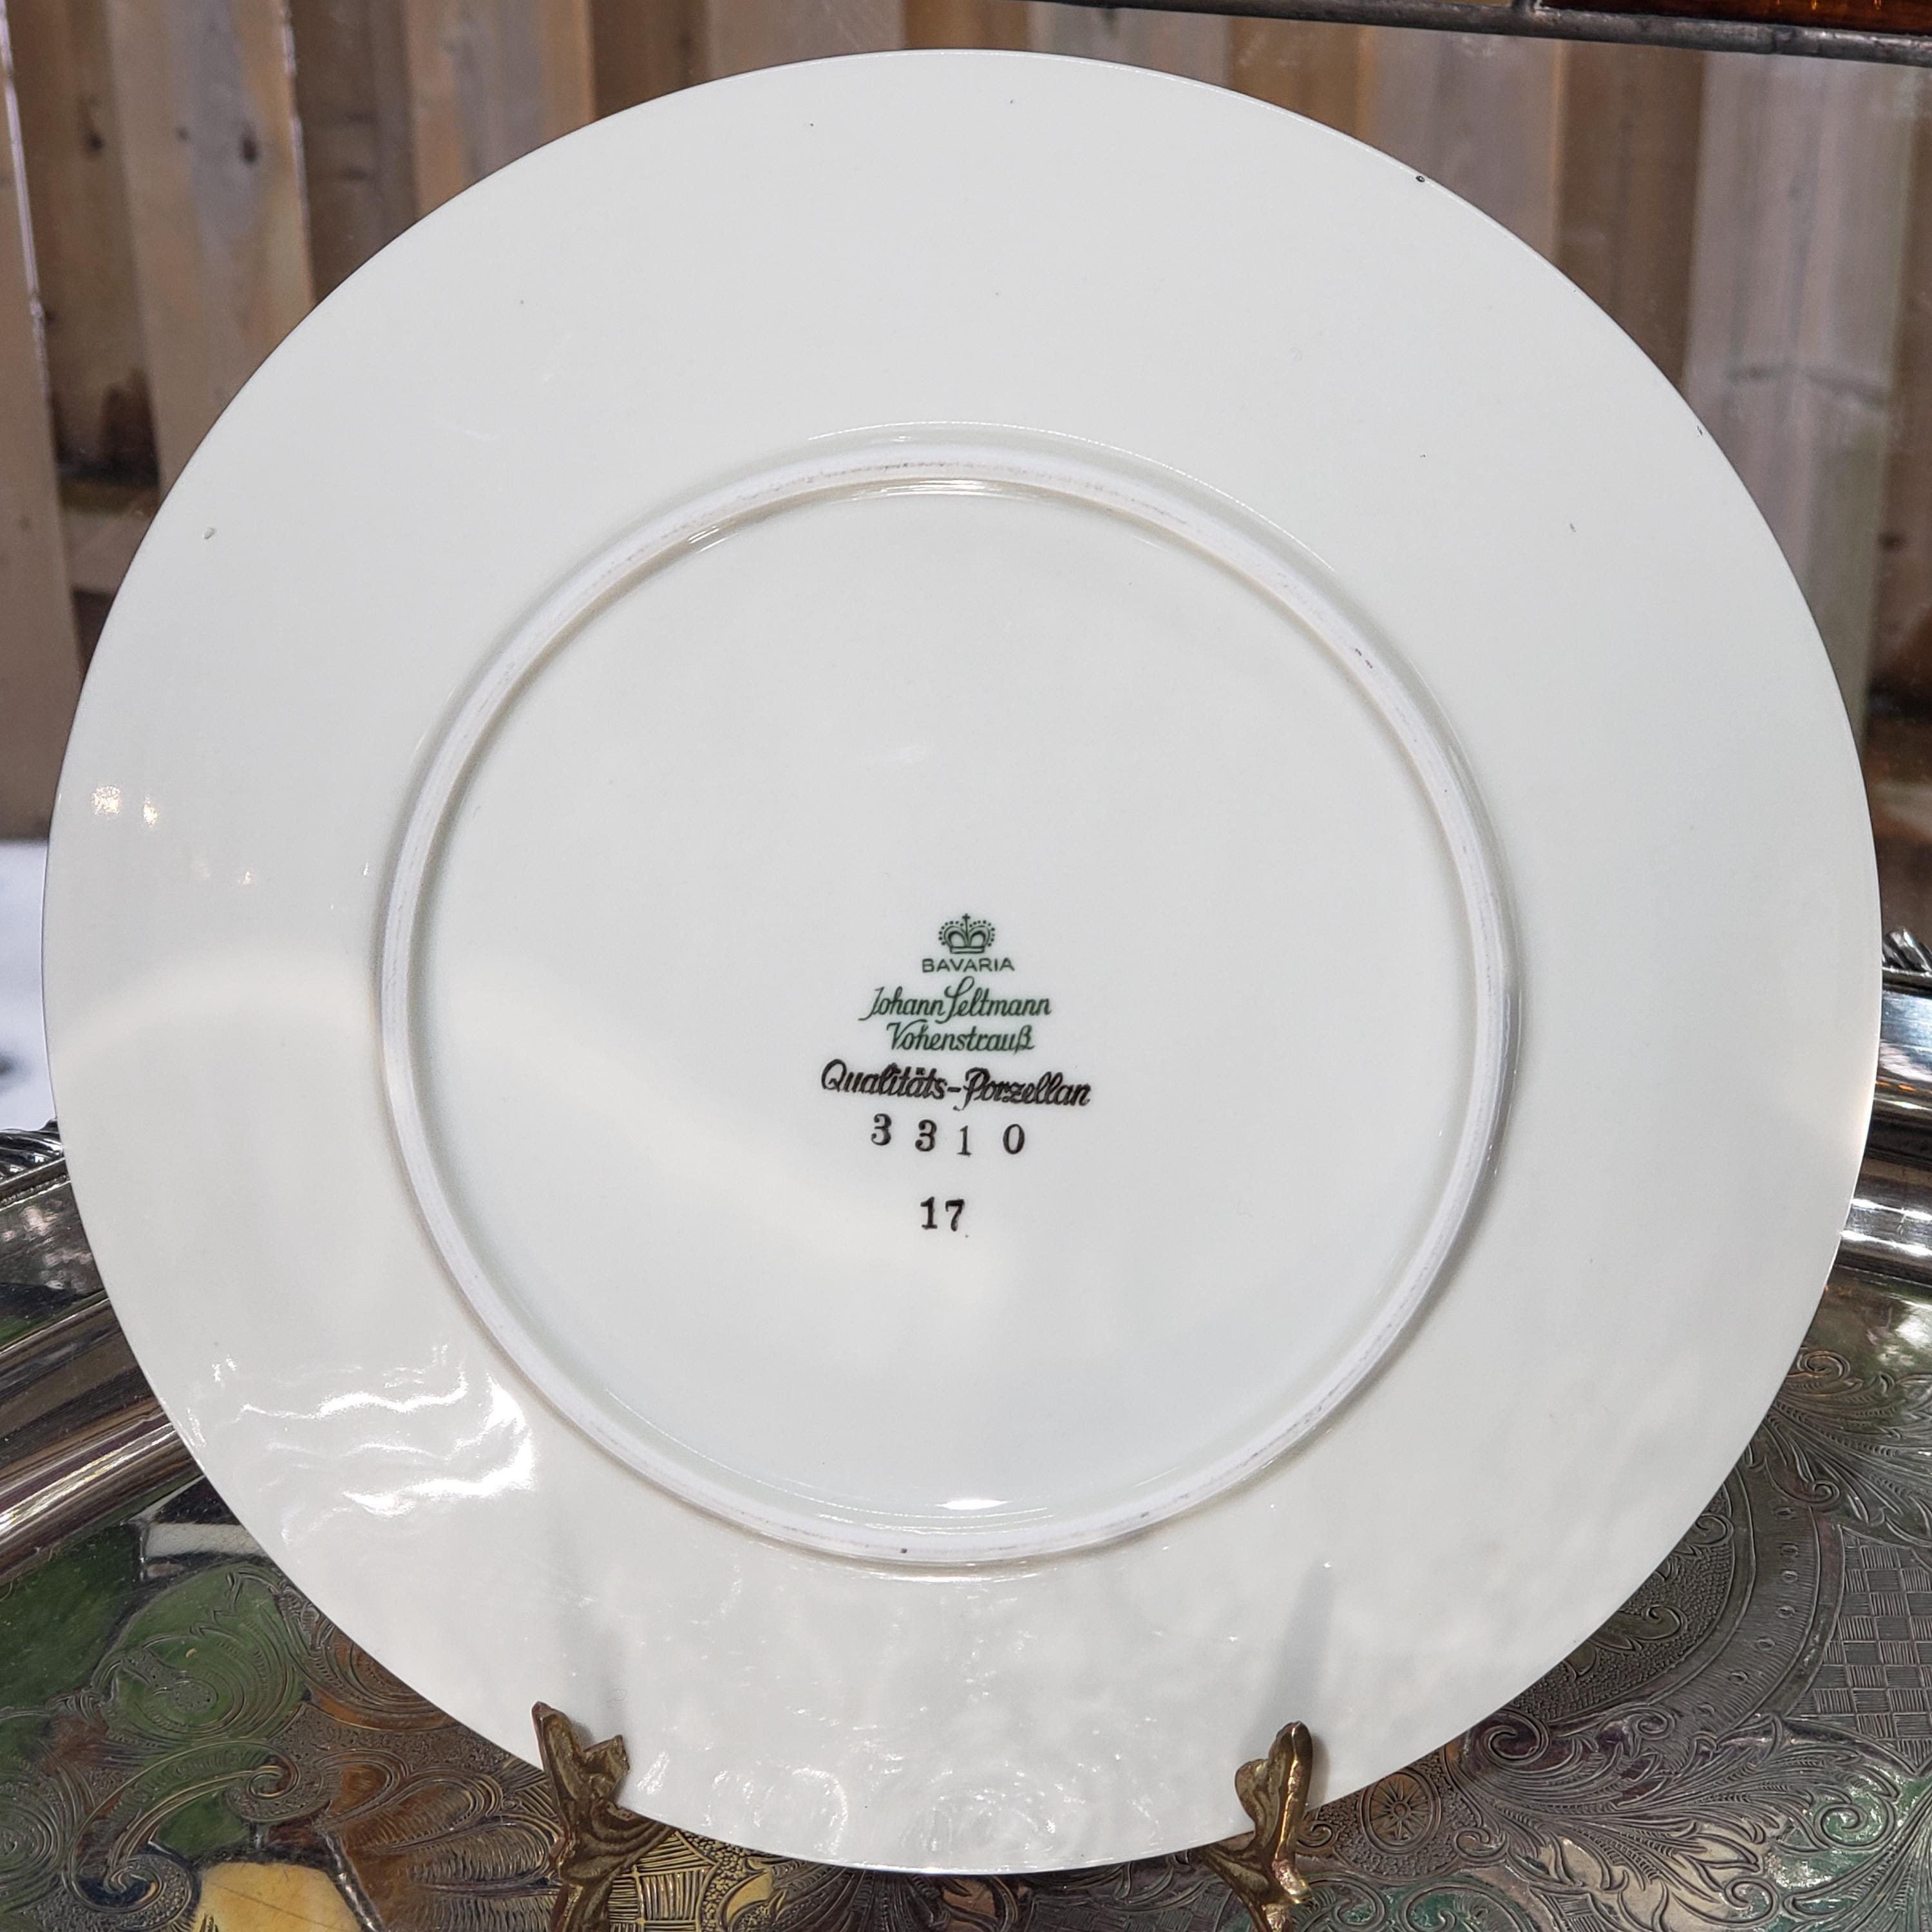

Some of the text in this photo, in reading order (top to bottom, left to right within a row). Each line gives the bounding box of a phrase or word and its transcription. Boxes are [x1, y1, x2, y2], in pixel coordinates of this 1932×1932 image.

[922, 956, 1016, 974] BAVARIA
[858, 976, 1052, 1024] Johann Seltmann
[886, 1019, 1036, 1055] Vohenstrauß
[920, 1196, 966, 1233] 17
